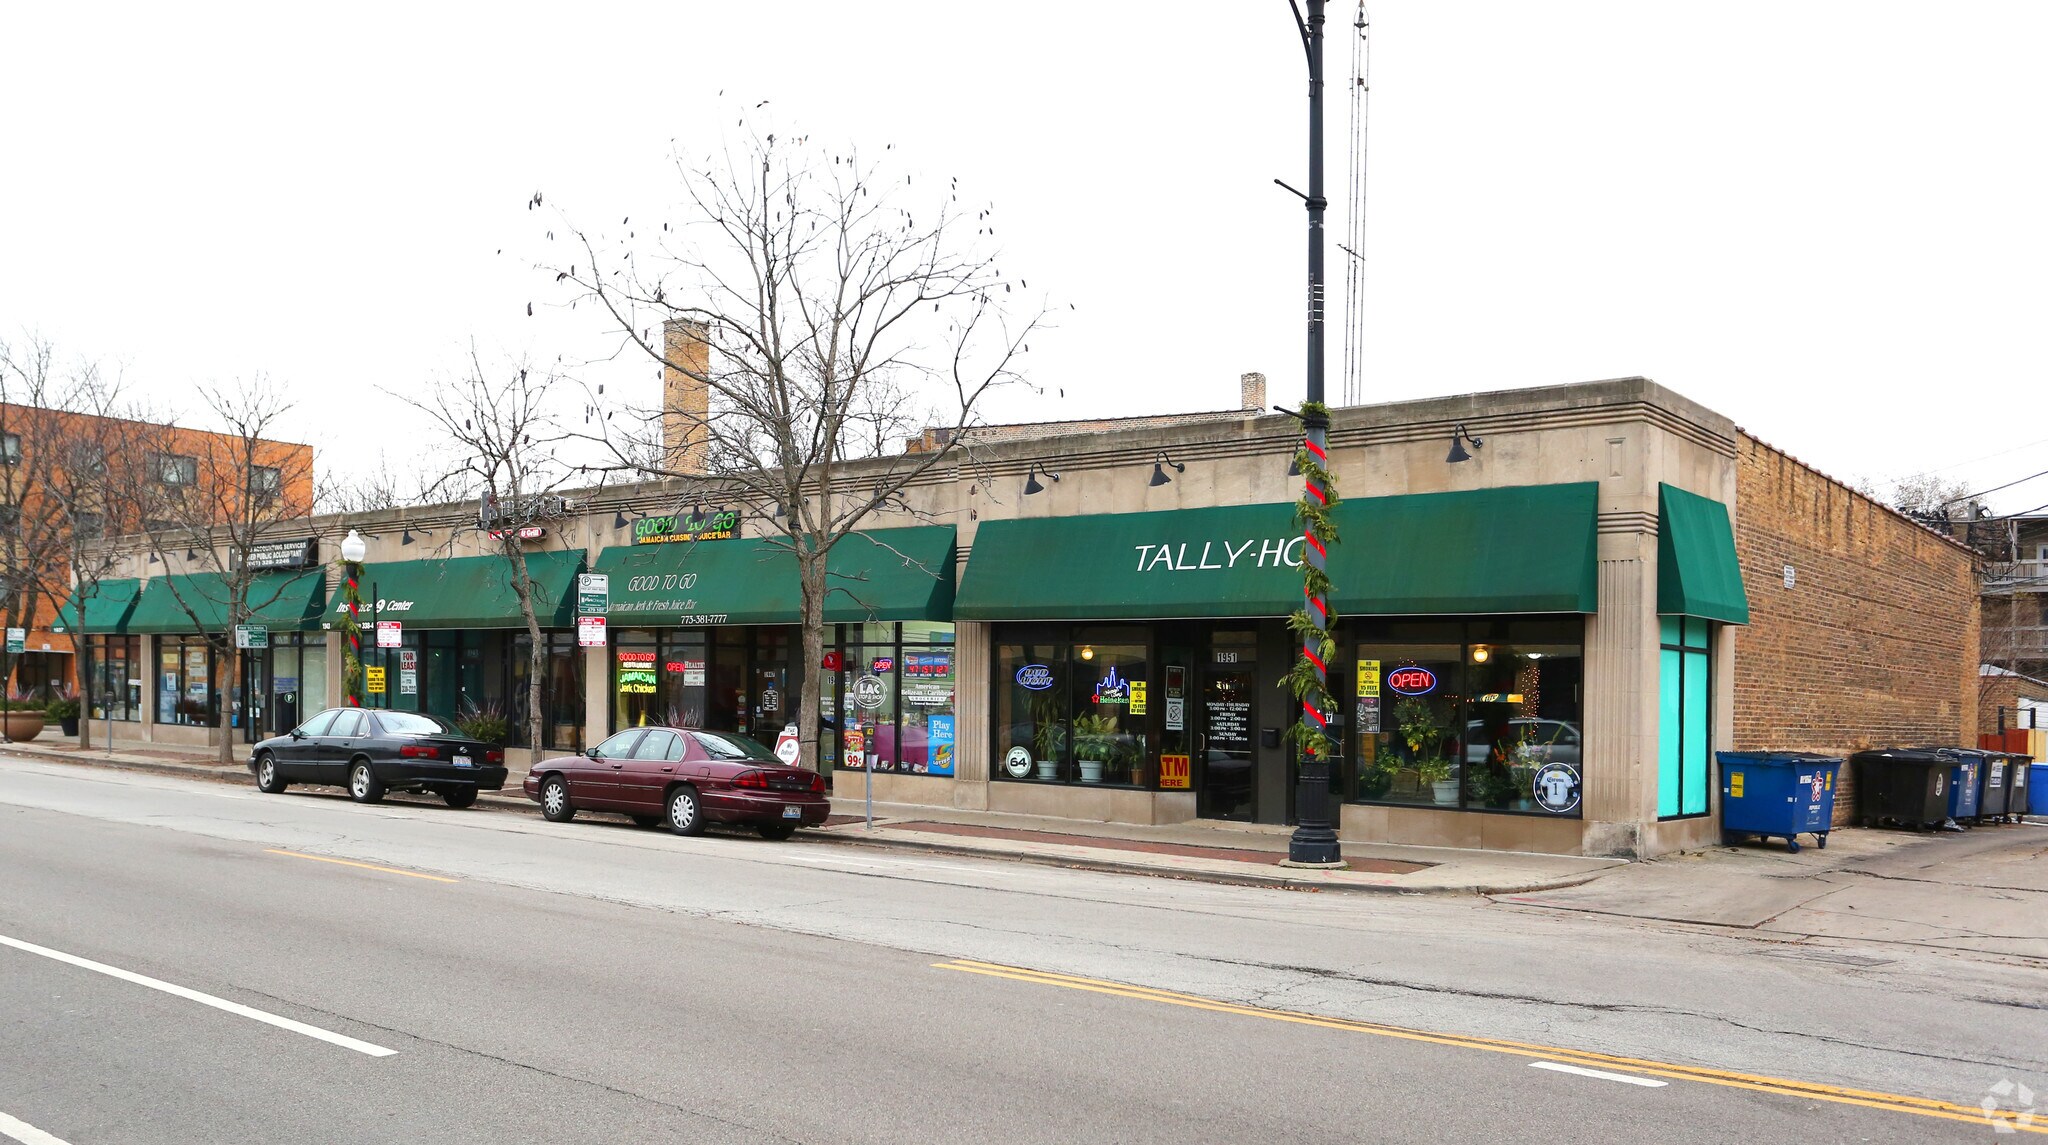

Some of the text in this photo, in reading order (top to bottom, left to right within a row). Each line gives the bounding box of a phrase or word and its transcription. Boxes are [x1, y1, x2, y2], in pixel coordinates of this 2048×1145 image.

[635, 517, 678, 539] GOOD
[712, 511, 735, 532] GO
[639, 534, 669, 544] JAMAICAN
[669, 533, 691, 543] CUISIN
[718, 531, 731, 540] BAR
[283, 542, 307, 550] SERVICES
[628, 573, 697, 592] GOOD TO GO
[387, 600, 413, 611] Center
[633, 601, 646, 611] Jerk
[652, 600, 670, 611] Fresh
[669, 600, 684, 611] Juice
[685, 599, 697, 610] Bar
[681, 614, 727, 625] 773-381-7777
[402, 652, 414, 660] FOR
[619, 653, 656, 662] GOOD TO GO
[1217, 652, 1237, 663] 1951
[666, 662, 685, 672] OPEN
[1024, 668, 1049, 677] BUD
[620, 672, 656, 684] JAMAICAN
[1021, 677, 1054, 685] LIGHT
[1391, 672, 1430, 688] OPEN
[620, 684, 656, 693] Jerk Chicken
[860, 684, 880, 694] LAC
[1100, 696, 1130, 704] Heineken
[932, 720, 950, 731] Play
[933, 729, 952, 738] Here
[933, 754, 954, 766] LOTTERY
[1010, 757, 1027, 767] 64
